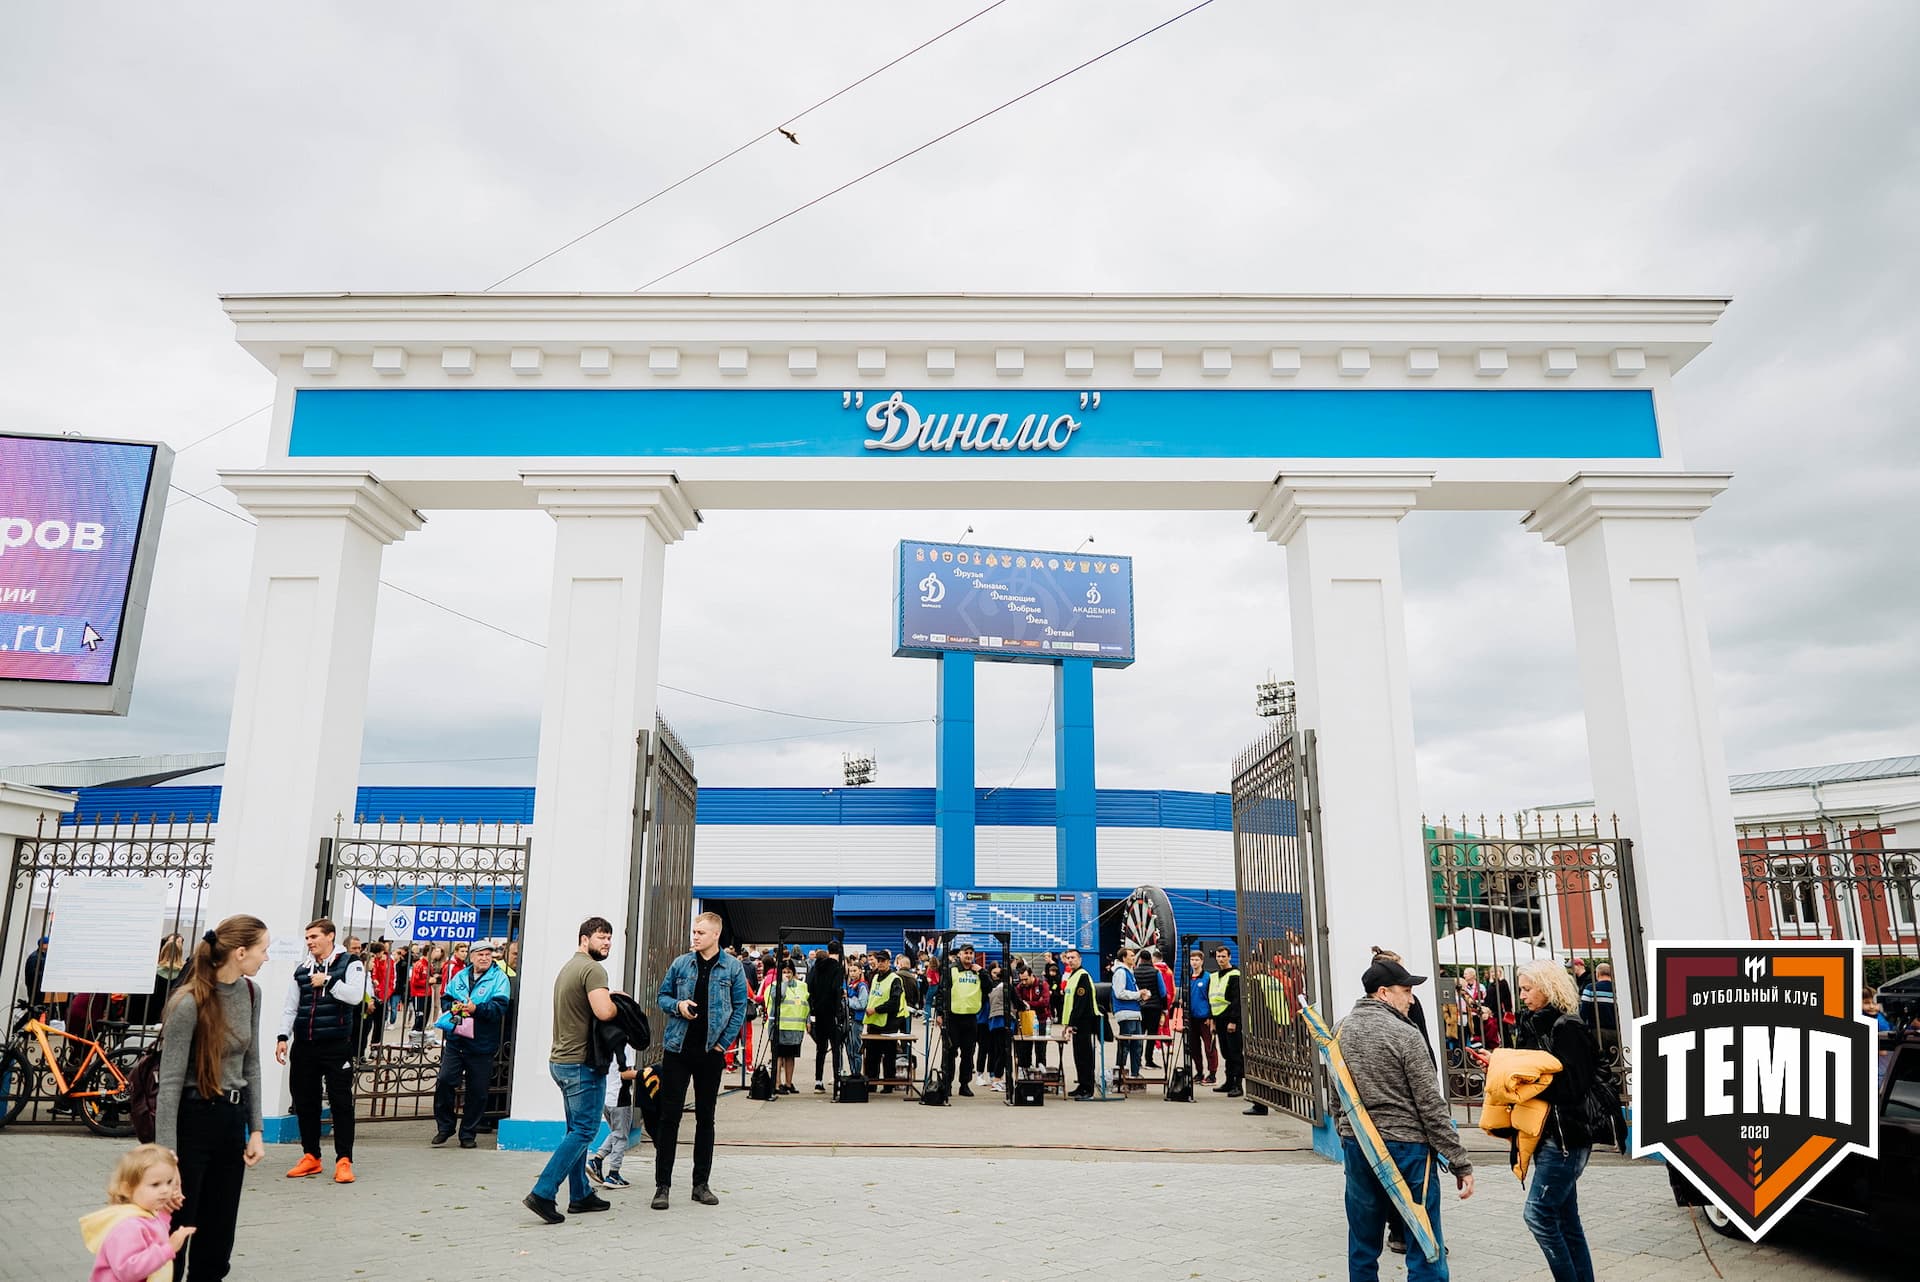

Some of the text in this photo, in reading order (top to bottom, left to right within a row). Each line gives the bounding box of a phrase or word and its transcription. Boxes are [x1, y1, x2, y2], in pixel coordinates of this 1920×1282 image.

[0, 587, 36, 603] ии
[1072, 606, 1116, 615] АКАДЕМИЯ
[418, 910, 477, 924] СЕГОДНЯ
[417, 926, 475, 938] ФУТБОЛ
